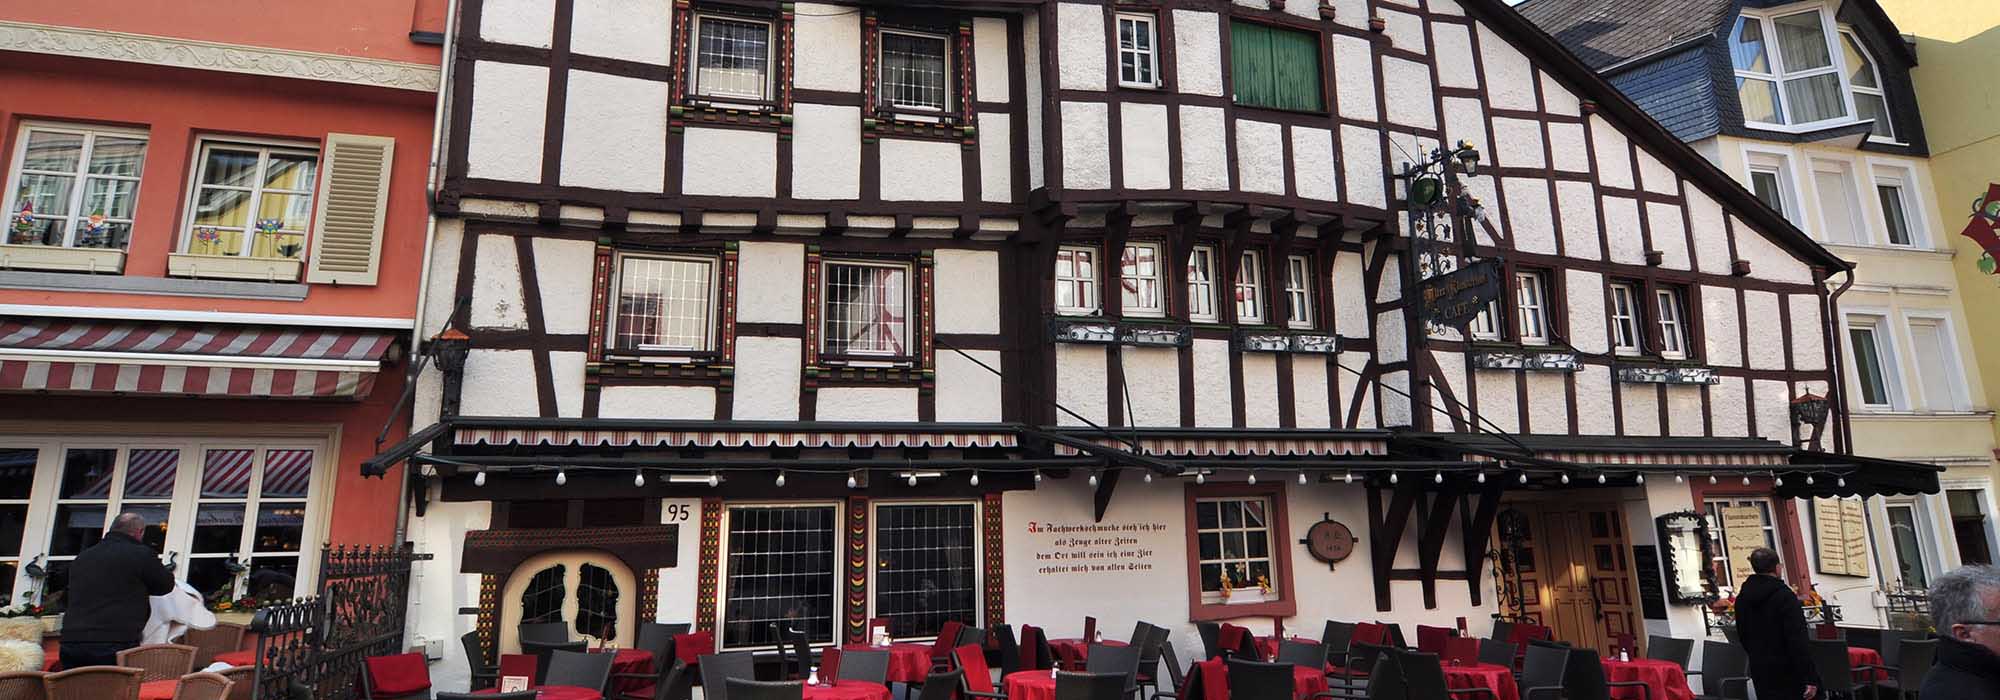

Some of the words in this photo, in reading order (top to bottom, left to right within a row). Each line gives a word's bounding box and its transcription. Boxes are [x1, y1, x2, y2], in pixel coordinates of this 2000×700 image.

[668, 504, 690, 521] 95
[1028, 521, 1044, 533] Im
[1036, 552, 1051, 560] dem
[1071, 551, 1086, 559] will
